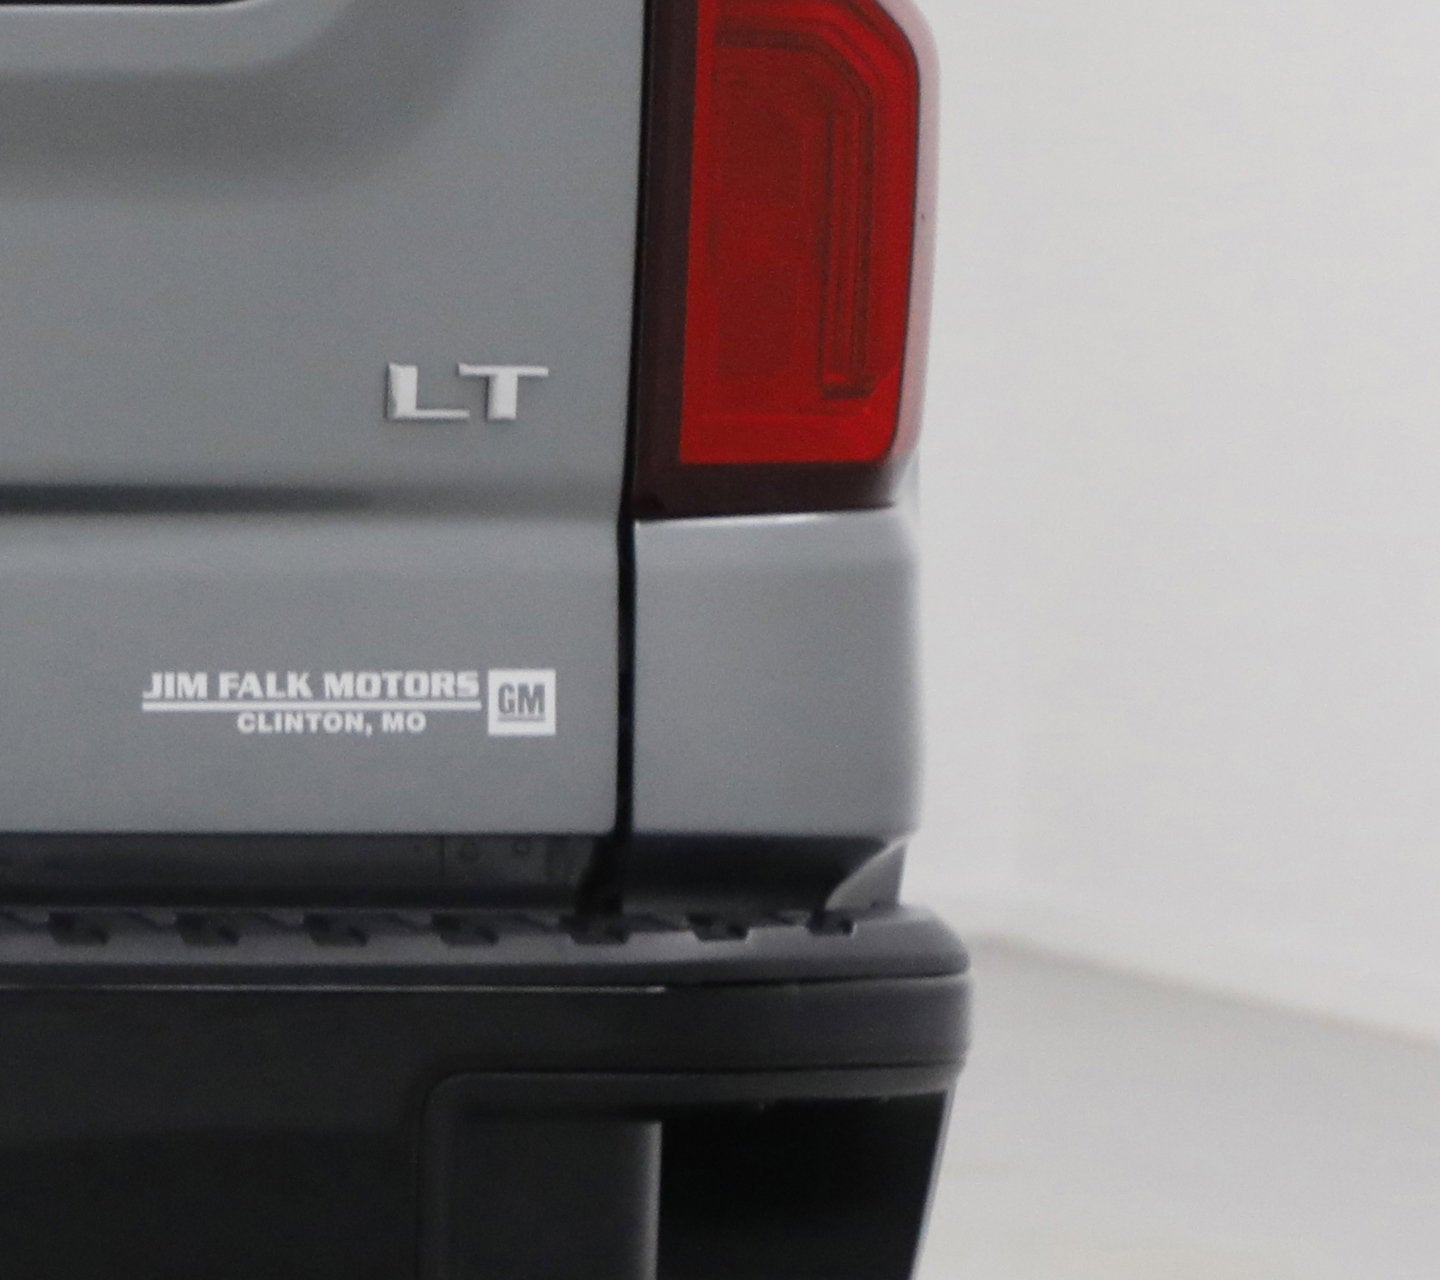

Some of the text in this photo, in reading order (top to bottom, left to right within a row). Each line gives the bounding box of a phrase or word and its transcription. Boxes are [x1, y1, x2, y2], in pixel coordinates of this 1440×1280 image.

[386, 362, 550, 420] LT
[143, 671, 481, 699] JIM FALK MOTORS
[496, 682, 547, 721] GM
[236, 711, 428, 738] CLINTON, MO
